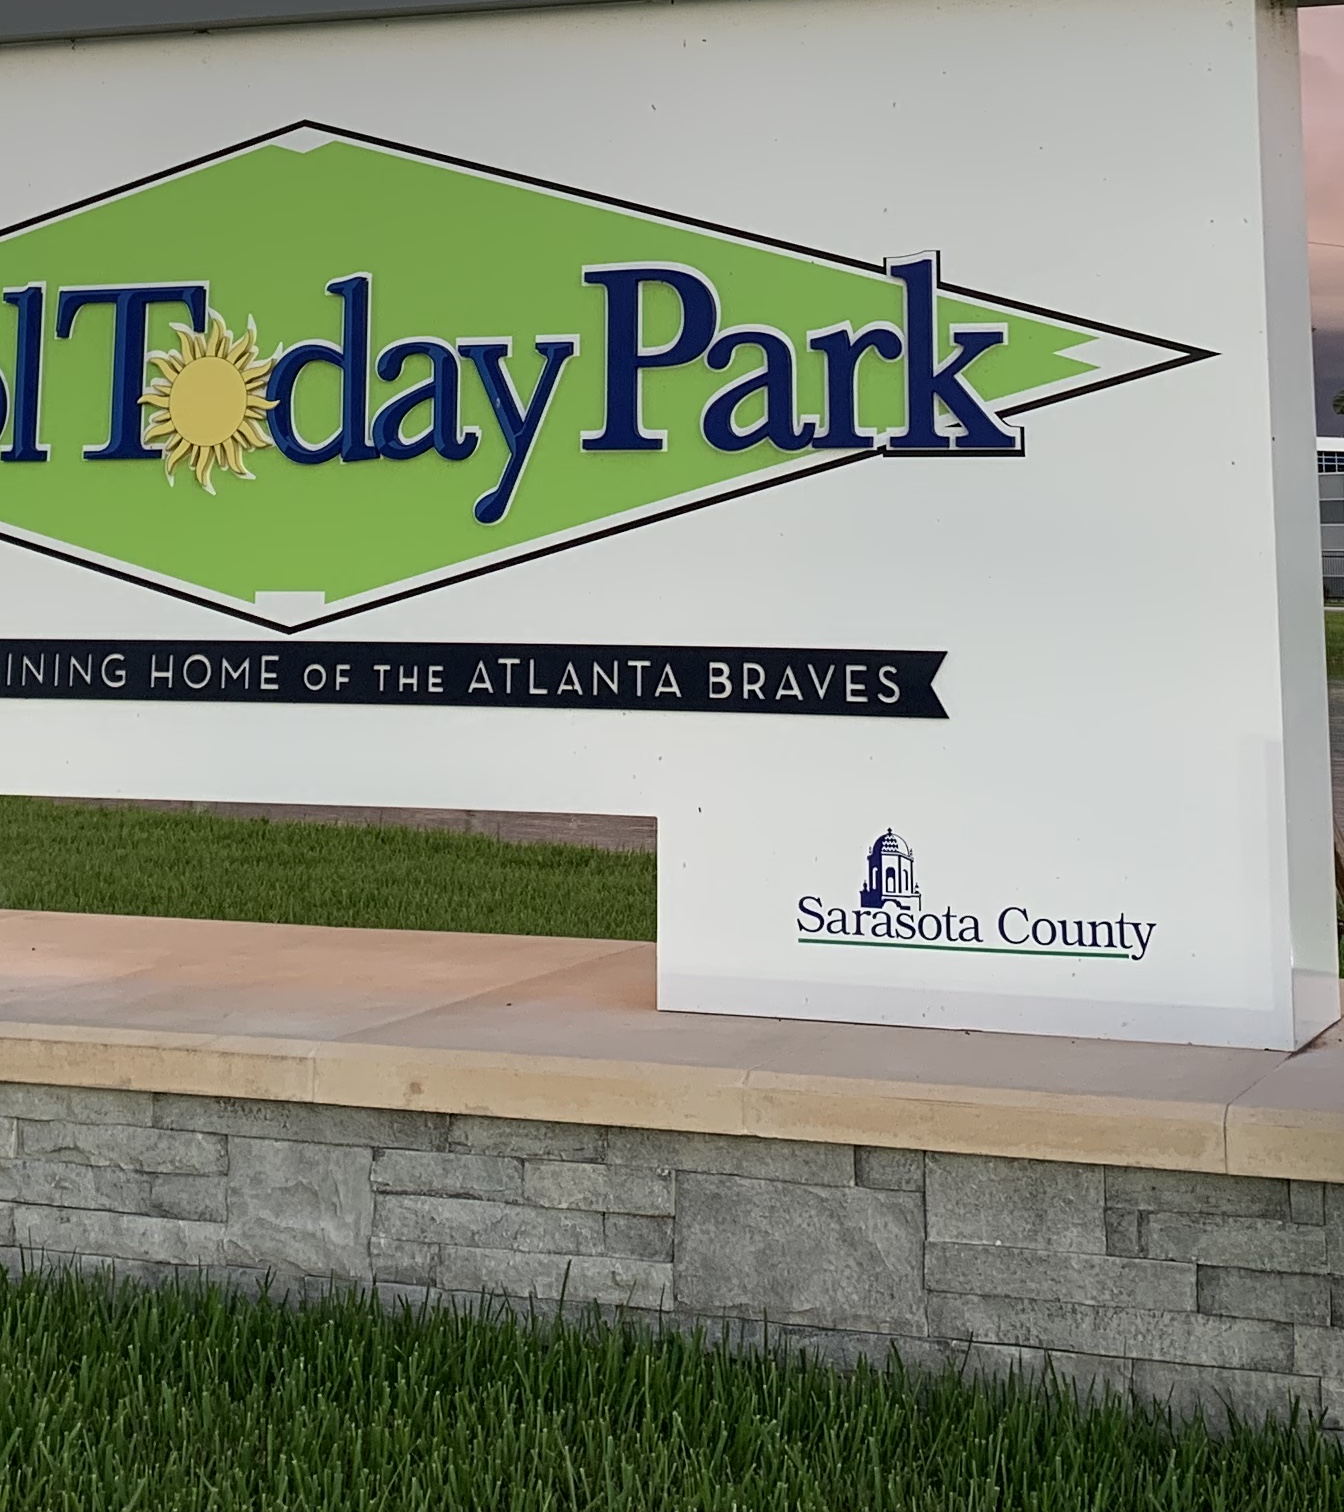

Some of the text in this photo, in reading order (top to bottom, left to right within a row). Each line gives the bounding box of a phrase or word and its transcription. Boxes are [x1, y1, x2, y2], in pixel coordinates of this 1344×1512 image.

[581, 256, 1020, 452] Park
[149, 653, 280, 692] HOME
[303, 663, 350, 691] OF
[373, 664, 444, 694] THE
[467, 657, 682, 699] ATLANTA
[708, 661, 901, 704] BRAVES
[797, 896, 1157, 960] Sarasota County
